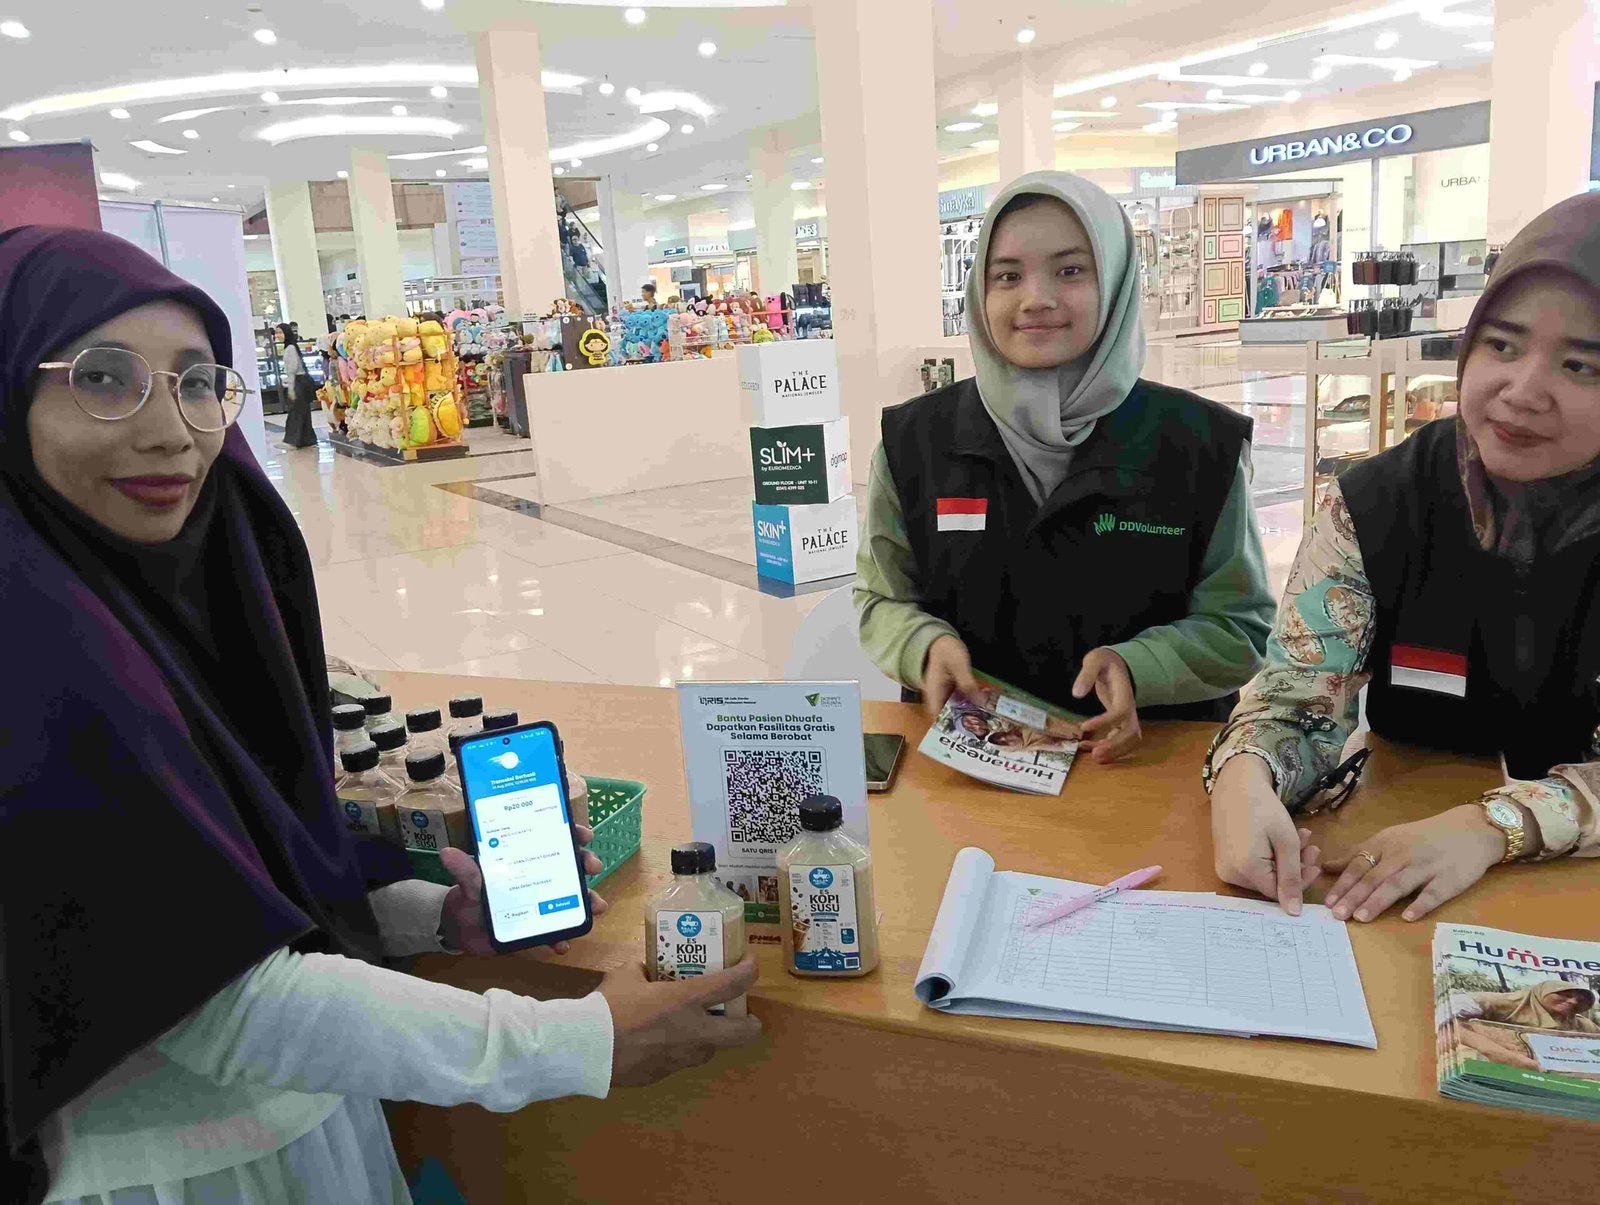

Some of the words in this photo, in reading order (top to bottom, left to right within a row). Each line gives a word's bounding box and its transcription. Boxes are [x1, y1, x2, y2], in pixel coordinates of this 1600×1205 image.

[1249, 123, 1413, 165] URBAN&CO
[1441, 176, 1481, 188] URBA
[774, 375, 827, 393] PALACE
[760, 446, 815, 465] SLIM+
[757, 520, 786, 540] SKIN+
[1119, 521, 1186, 535] DDVolunteer
[802, 530, 848, 551] PALACE
[717, 714, 746, 722] Bantu
[749, 714, 783, 722] Pasien
[785, 714, 823, 723] Dhuafa
[706, 723, 757, 732] Dapatkan
[759, 723, 801, 731] Fasilitas
[803, 723, 835, 732] Gratis
[731, 732, 768, 740] Selama
[771, 732, 812, 740] Berobat
[939, 735, 1054, 780] Humanesia
[414, 832, 436, 842] KOPI
[416, 840, 437, 848] SUSU
[809, 894, 840, 904] KOPI
[810, 904, 840, 912] SUSU
[676, 944, 706, 954] KOPI
[676, 954, 707, 964] SUSU
[1459, 940, 1600, 972] Humane
